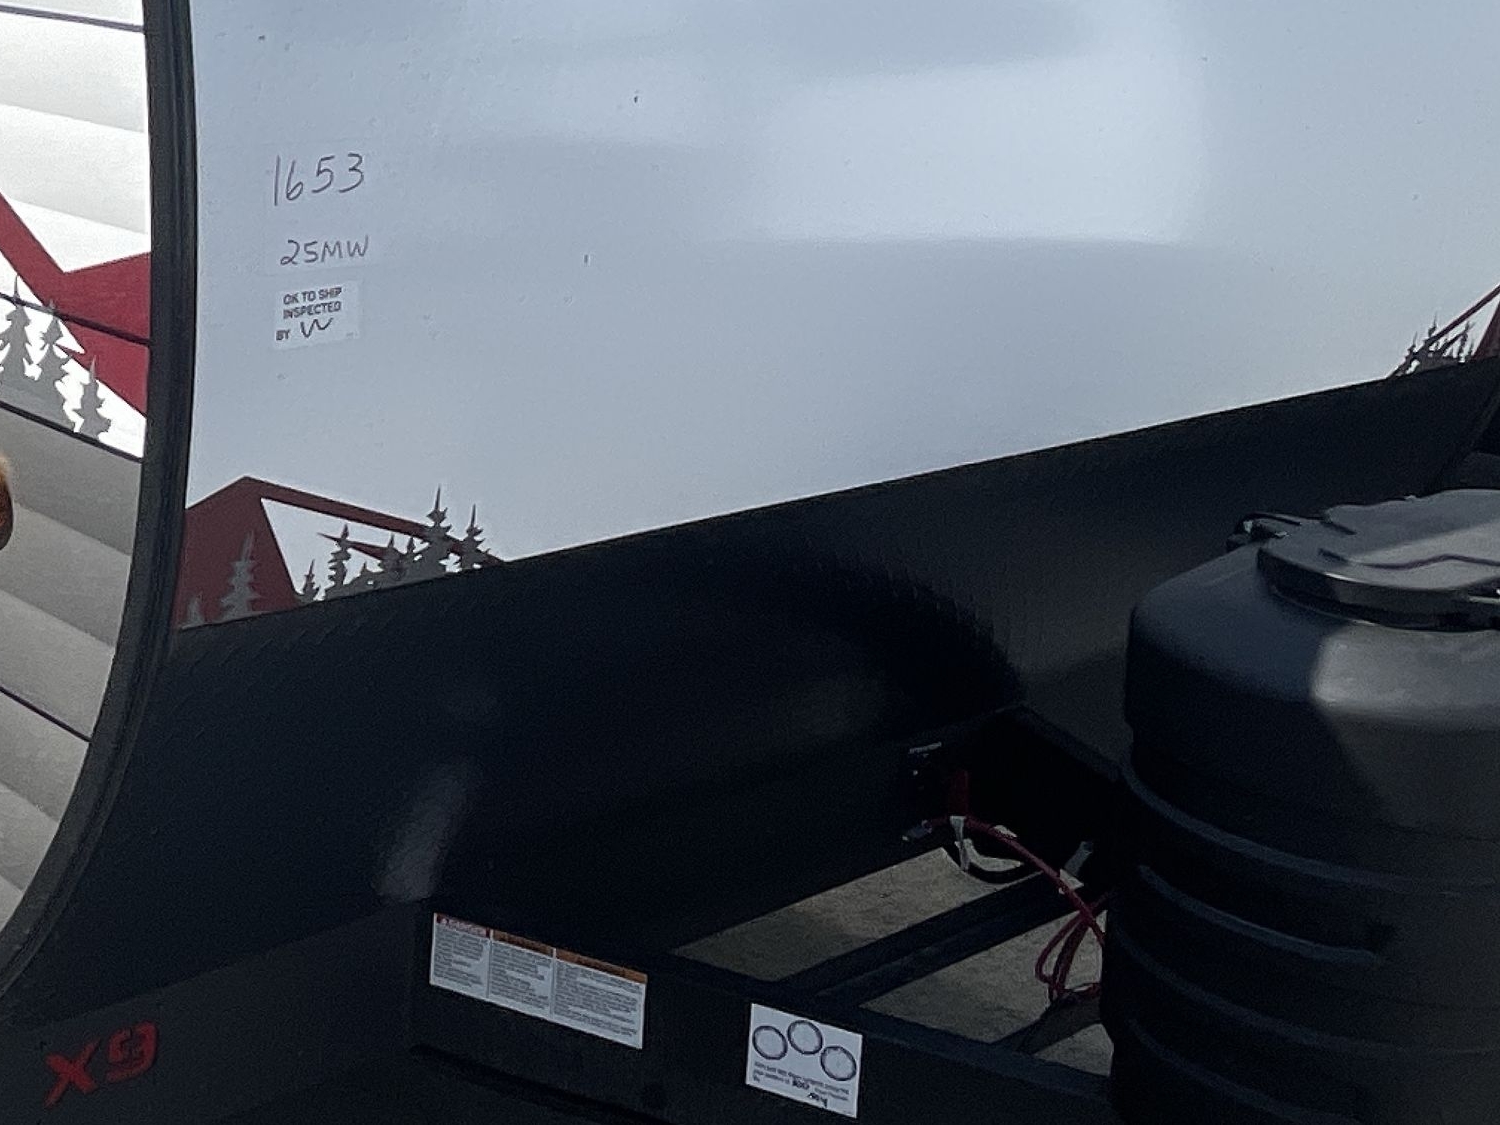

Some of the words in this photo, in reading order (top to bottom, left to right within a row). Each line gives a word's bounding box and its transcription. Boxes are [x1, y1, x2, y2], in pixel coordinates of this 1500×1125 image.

[273, 152, 365, 207] 1653
[280, 234, 369, 266] 25MW
[283, 292, 299, 305] OK
[301, 290, 316, 302] TO
[318, 286, 342, 300] SHIP
[282, 300, 342, 320] INSPECTED
[275, 329, 291, 341] BY
[43, 1020, 158, 1109] X9
